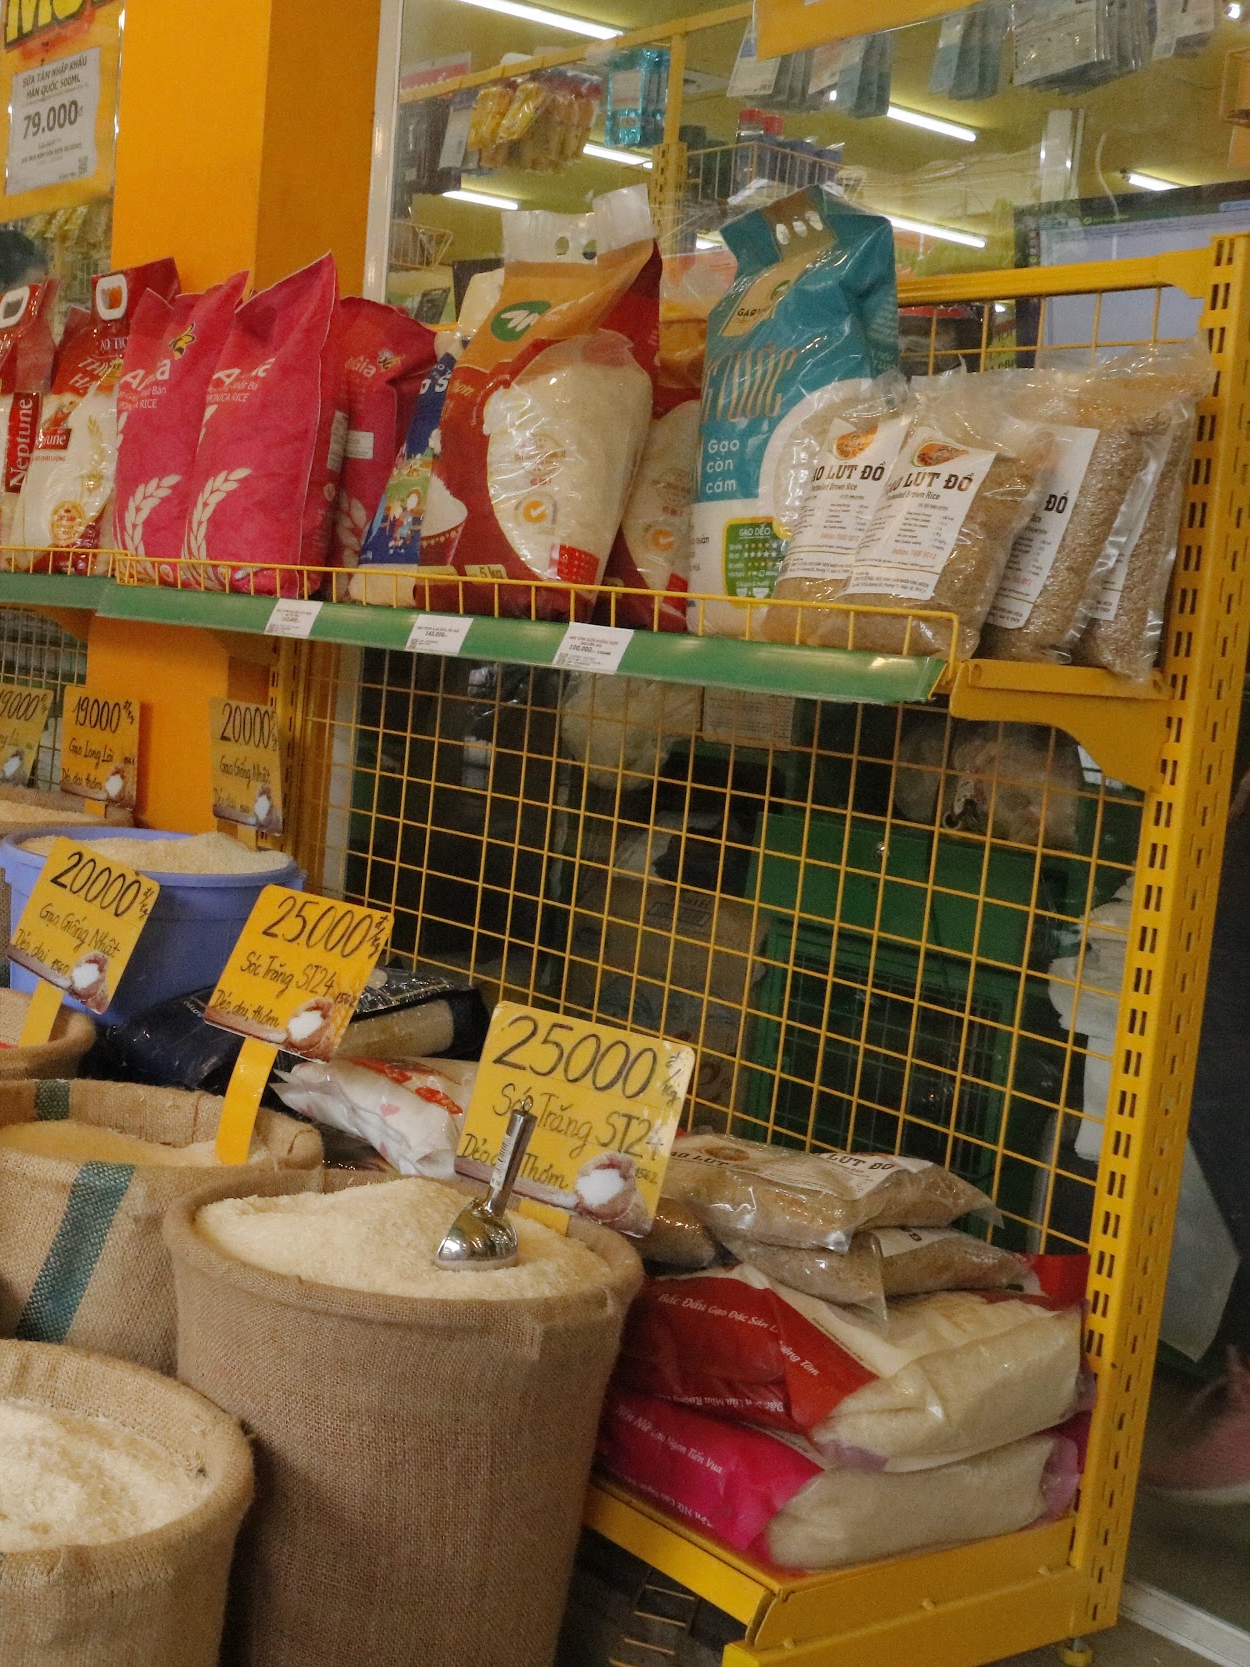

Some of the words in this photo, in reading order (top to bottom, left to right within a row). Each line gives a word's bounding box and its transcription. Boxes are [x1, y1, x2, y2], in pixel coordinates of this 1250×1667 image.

[139, 398, 158, 410] RICE
[8, 397, 34, 488] Neptune
[707, 439, 740, 457] Gạo
[706, 458, 734, 473] còn
[826, 461, 858, 481] LỨT
[860, 461, 886, 482] ĐỎ
[705, 477, 737, 494] cám
[903, 468, 941, 489] LỨT
[943, 471, 975, 492] ĐỎ
[925, 491, 940, 501] Rice
[1043, 490, 1069, 514] ĐỎ
[479, 566, 487, 578] 5
[73, 695, 122, 734] 19000
[39, 902, 60, 928] Gạo
[61, 911, 90, 954] Giống
[88, 927, 121, 959] Nhật
[262, 895, 374, 959] 25.000
[240, 950, 261, 977] Sóc
[262, 955, 294, 999] Trăng
[295, 962, 338, 998] ST24
[492, 1014, 659, 1100] 25000
[537, 1091, 596, 1159] Trăng
[594, 1110, 666, 1161] ST24
[707, 1304, 728, 1317] Gạo
[748, 1315, 770, 1329] Sản
[705, 1457, 724, 1475] Vua
